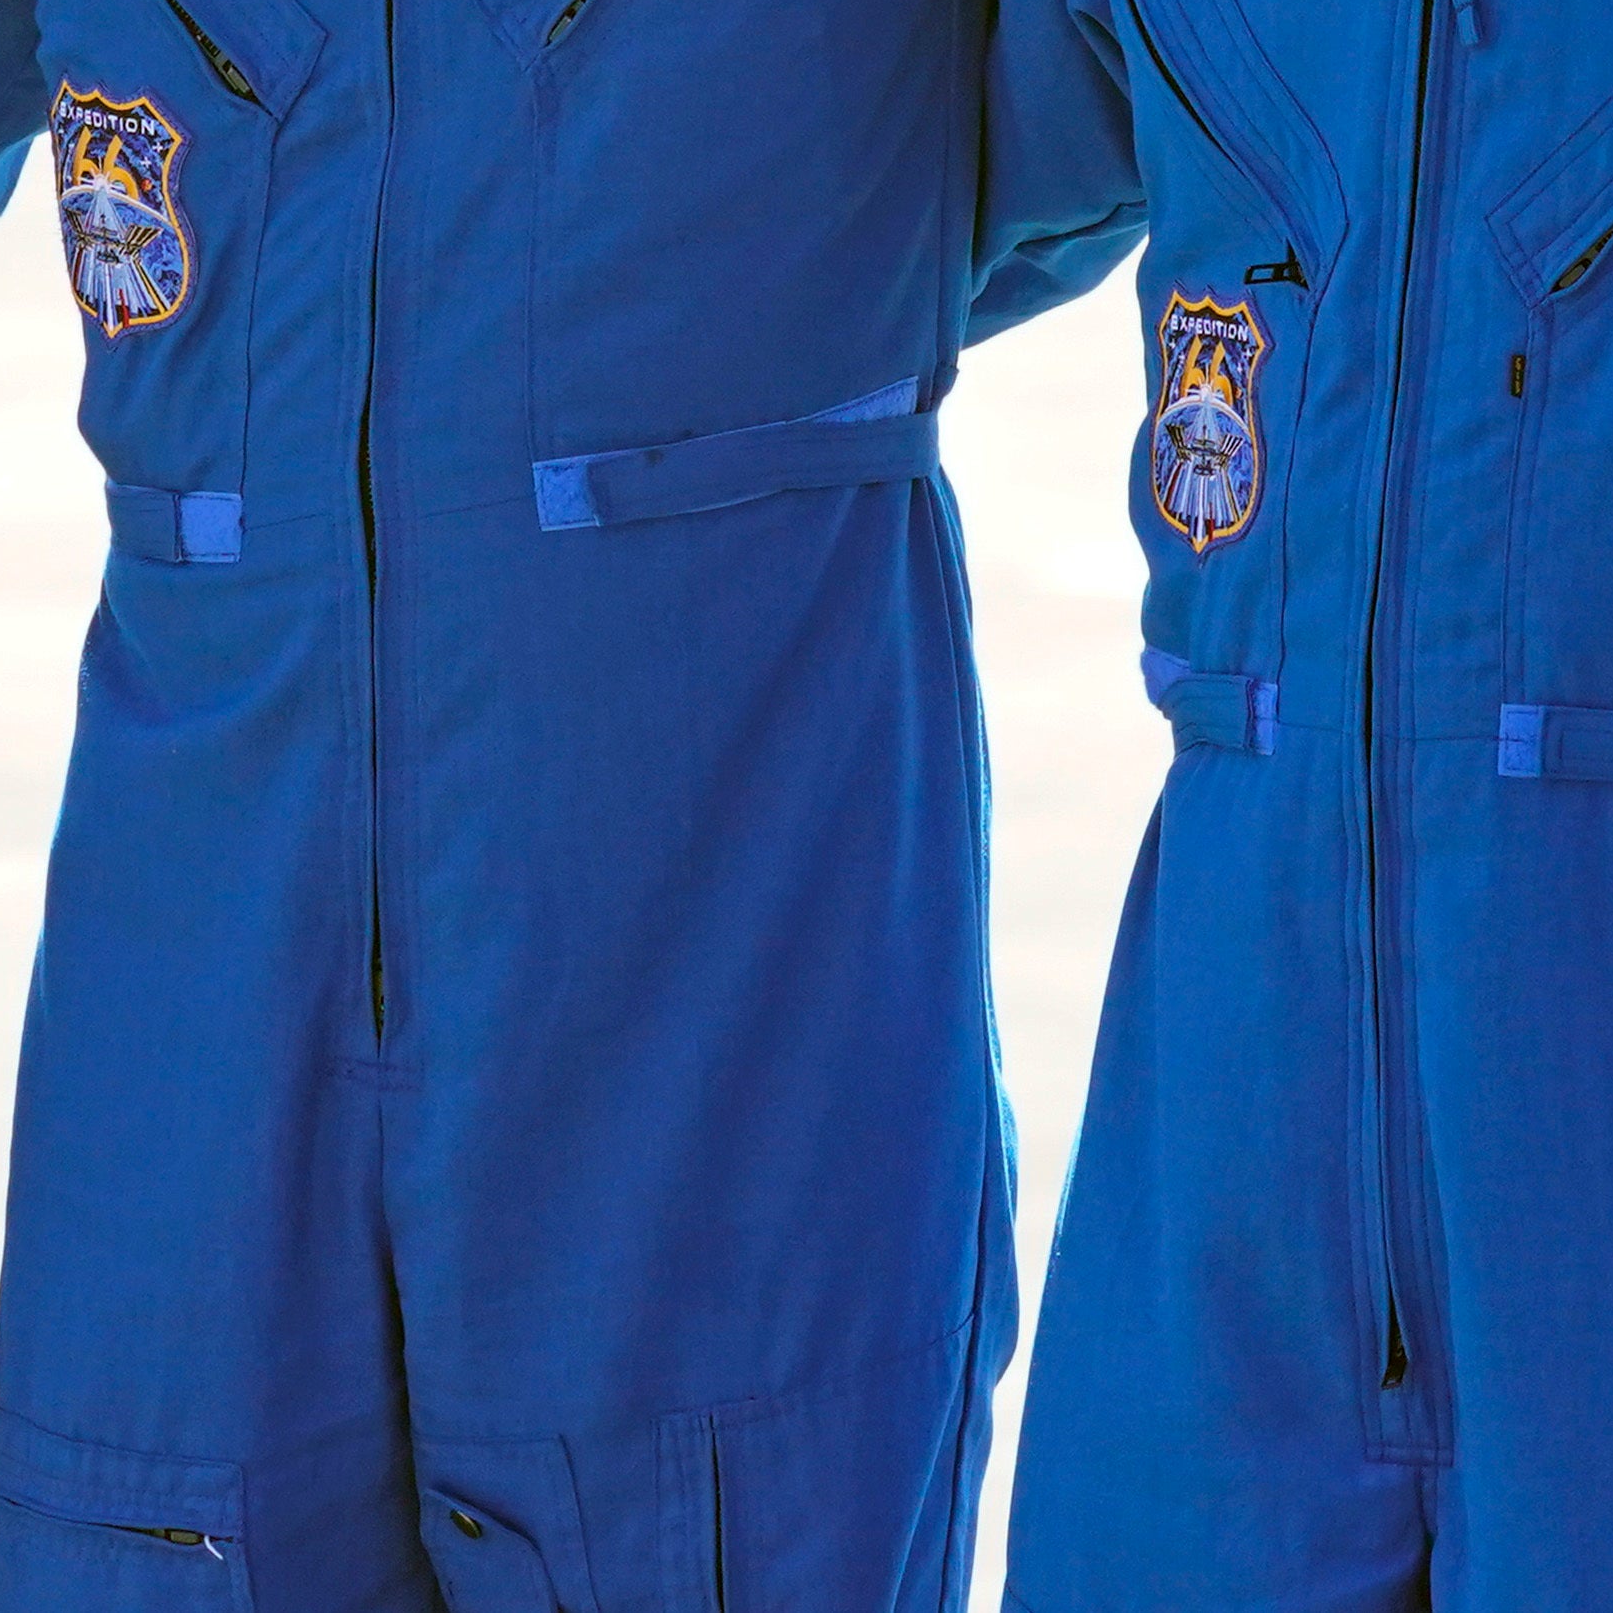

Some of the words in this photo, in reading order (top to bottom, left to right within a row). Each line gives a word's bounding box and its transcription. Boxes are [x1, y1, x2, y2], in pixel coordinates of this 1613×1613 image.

[60, 103, 156, 136] EXPEDITION
[74, 127, 139, 200] 66
[1171, 314, 1249, 341] EXPEDITION
